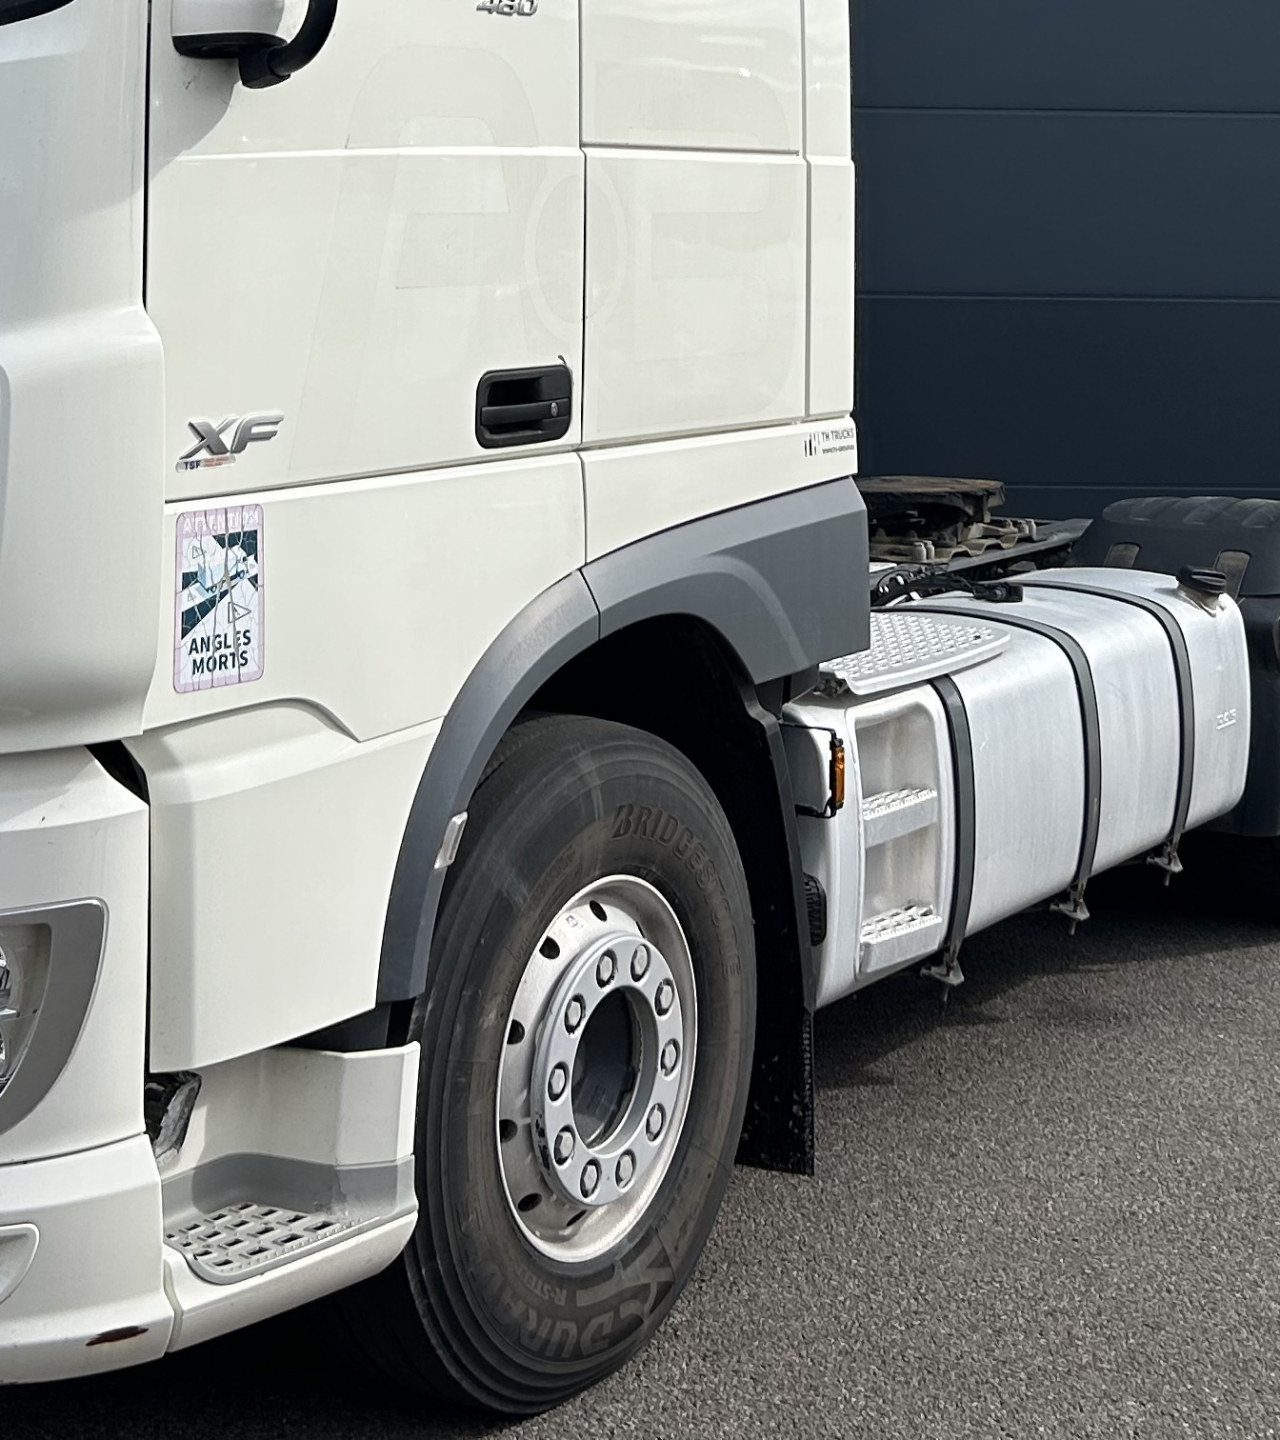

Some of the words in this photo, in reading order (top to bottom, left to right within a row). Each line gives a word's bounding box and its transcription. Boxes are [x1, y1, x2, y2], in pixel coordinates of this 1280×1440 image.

[179, 412, 285, 460] XF
[830, 428, 854, 440] TRUCKS
[188, 629, 252, 656] ANGLES
[191, 650, 249, 676] MORTS
